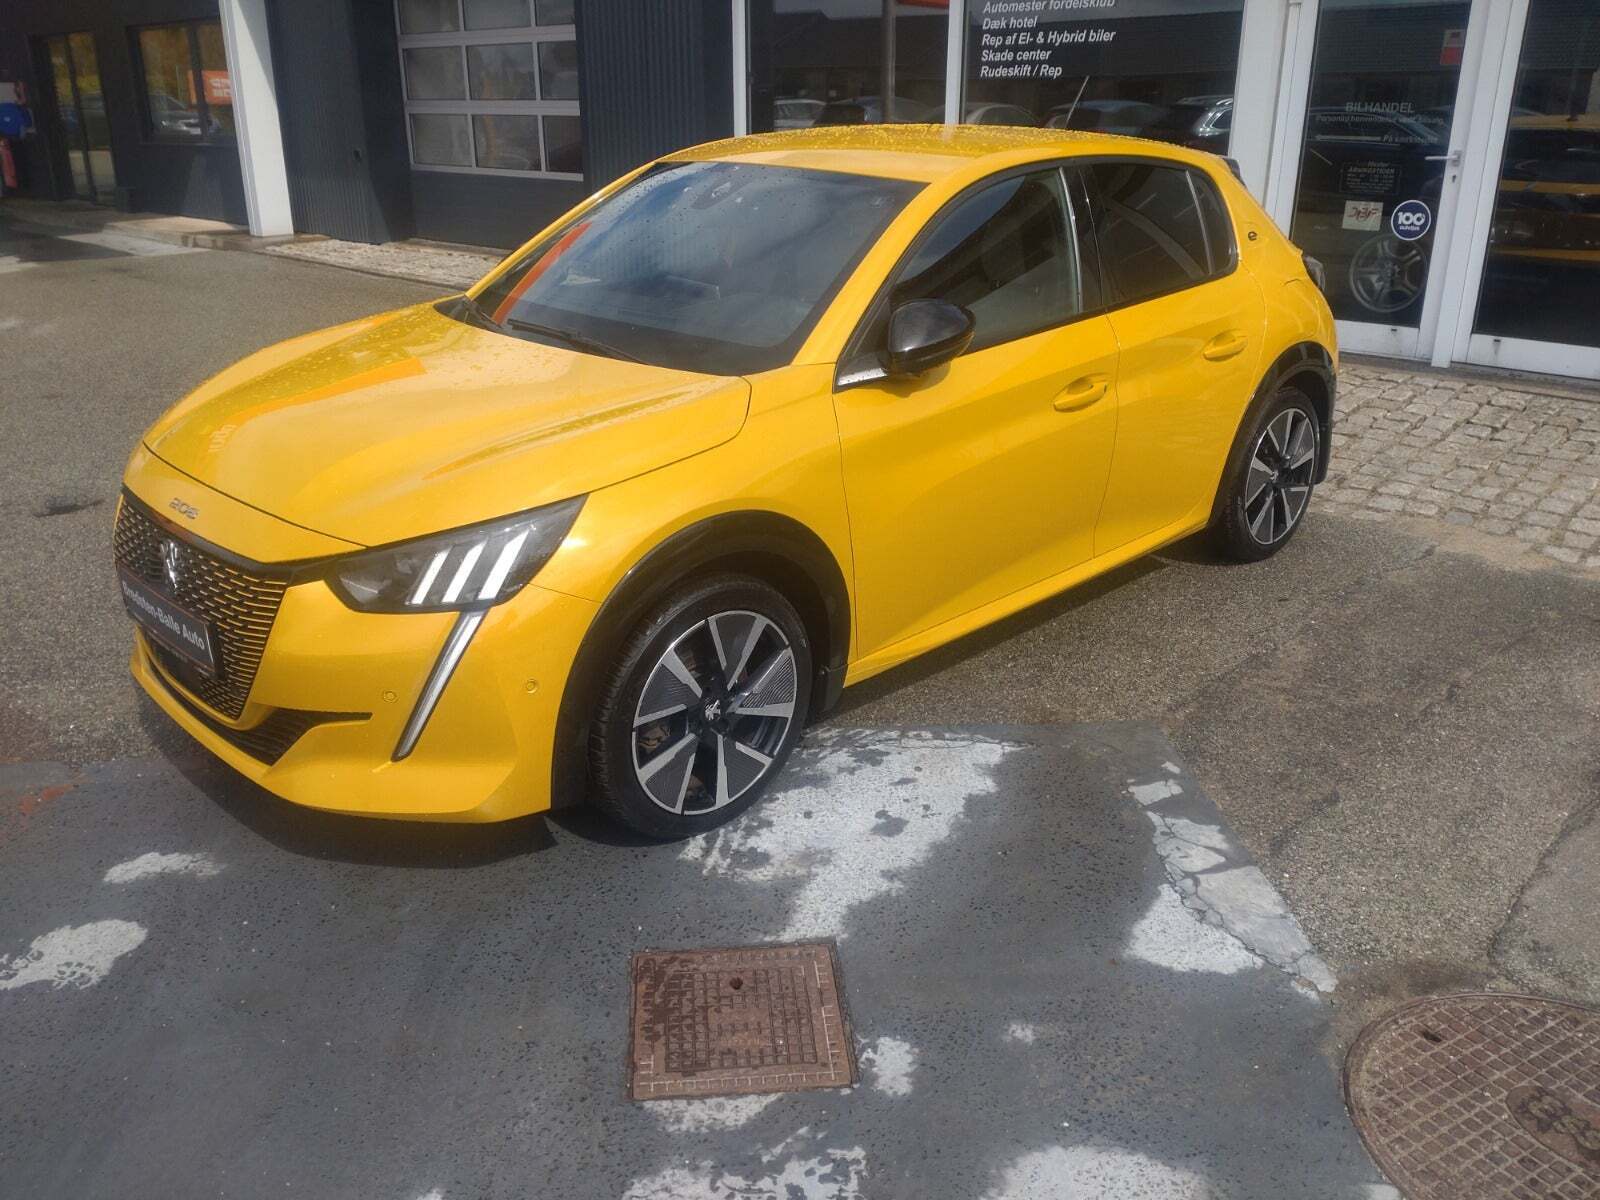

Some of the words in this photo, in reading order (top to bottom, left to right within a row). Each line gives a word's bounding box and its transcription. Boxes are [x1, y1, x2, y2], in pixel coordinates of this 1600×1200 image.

[983, 0, 1046, 14] Automester
[1048, 0, 1115, 10] fordelsklub
[982, 17, 1007, 30] Dæk
[1009, 15, 1038, 29] hotel
[982, 33, 1003, 48] Rep
[1005, 32, 1016, 45] af
[1018, 32, 1034, 45] El-
[1036, 31, 1045, 44] &
[1047, 29, 1088, 47] Hybrid
[1089, 29, 1117, 43] biler
[981, 49, 1014, 62] Skade
[1016, 50, 1052, 61] center
[980, 63, 1032, 78] Rudeskift
[1039, 64, 1063, 79] Rep
[1345, 102, 1415, 114] BILHANDEL
[1398, 212, 1425, 226] 100
[182, 624, 205, 650] Auto
